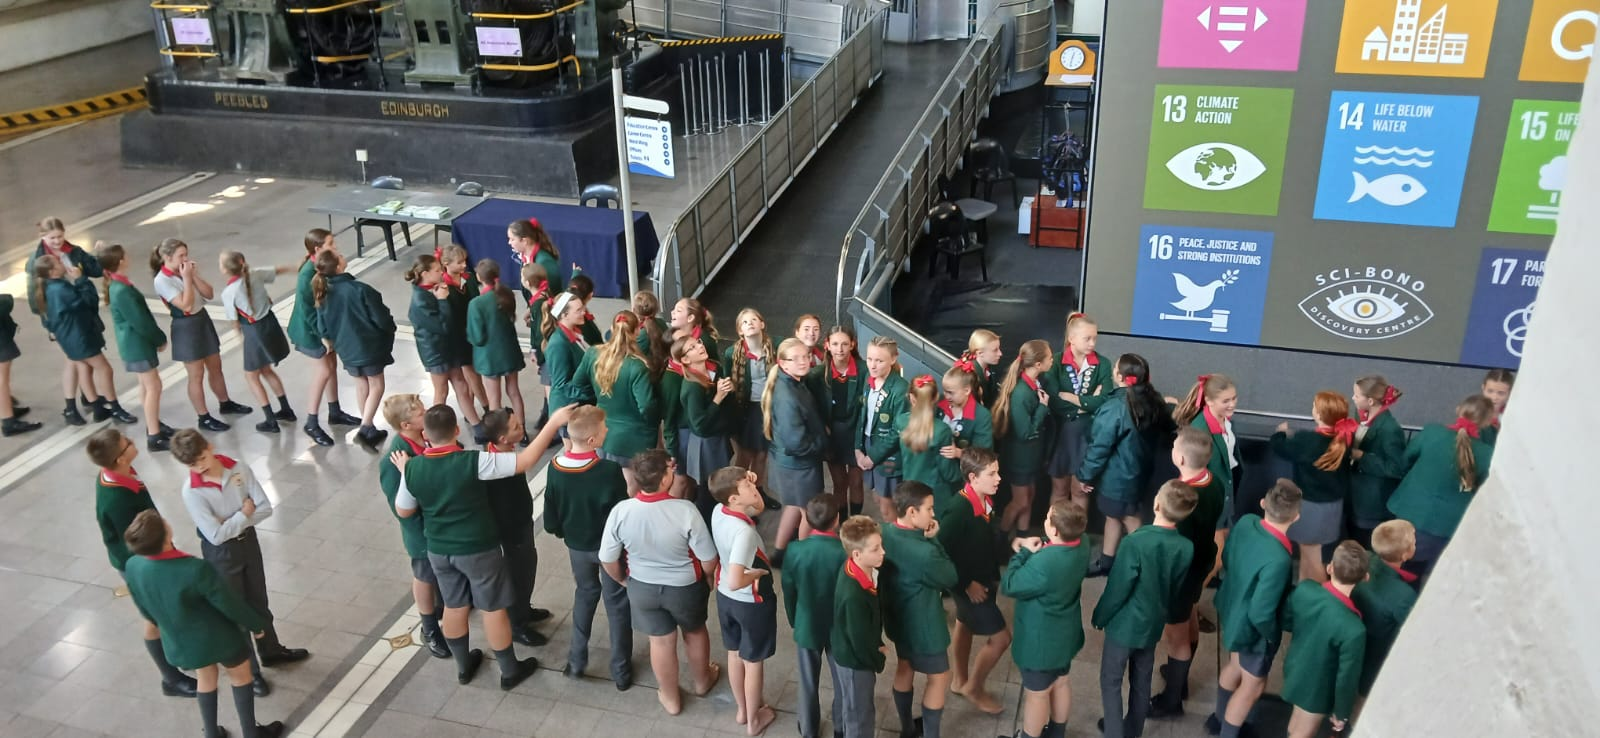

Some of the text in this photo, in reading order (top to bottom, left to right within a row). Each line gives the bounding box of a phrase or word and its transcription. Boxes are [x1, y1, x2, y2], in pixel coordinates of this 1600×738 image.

[214, 92, 269, 109] PEEBLES
[1196, 95, 1240, 110] CLIMATE
[381, 101, 449, 118] EDINBURGH
[1162, 95, 1187, 123] 13
[1338, 101, 1365, 130] 14
[1374, 103, 1434, 118] LIFE BELOW
[1194, 111, 1233, 124] ACTION
[1558, 112, 1581, 126] LIFE
[1372, 119, 1407, 133] WATER
[1520, 111, 1549, 141] 15
[1554, 128, 1571, 142] ON
[1149, 234, 1173, 260] 16
[1206, 239, 1238, 250] JUSTICE
[1239, 241, 1257, 252] AND
[1177, 251, 1261, 266] STRONG INSTITUTIONS
[1315, 266, 1425, 292] SCI-BONO
[1491, 257, 1518, 285] 17
[1521, 274, 1542, 287] FOR
[1310, 306, 1420, 335] DISCOVERY CENTRE
